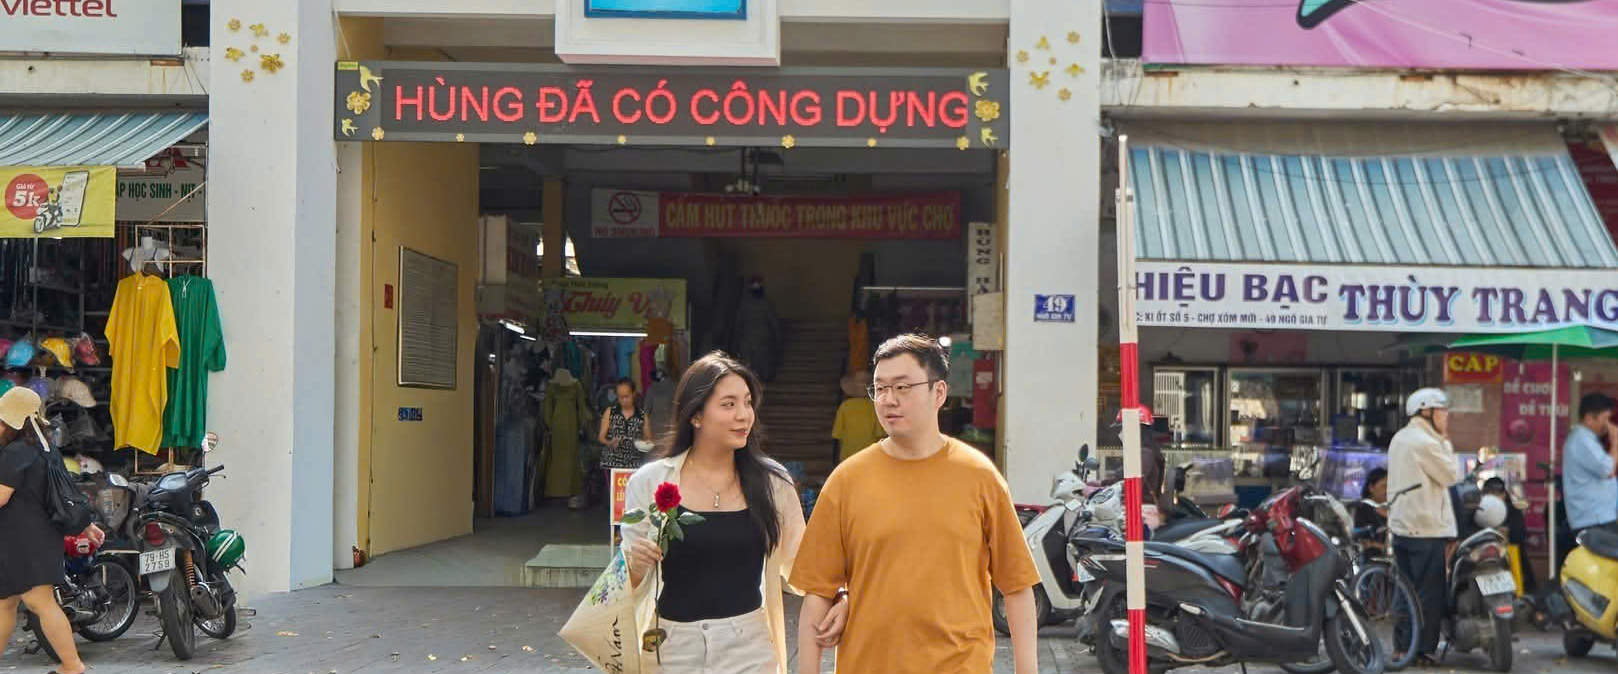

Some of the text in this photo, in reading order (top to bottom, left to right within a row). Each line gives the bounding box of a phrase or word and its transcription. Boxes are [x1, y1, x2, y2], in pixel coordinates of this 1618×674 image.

[394, 76, 969, 133] HÙNG ĐÃ CÓ CÔNG DỰNG
[128, 183, 147, 201] HỌC
[149, 183, 172, 199] SINH
[1136, 266, 1329, 309] HIỆU BẠC
[1339, 274, 1618, 325] THÙY TRANG
[1043, 296, 1066, 313] 49
[1184, 313, 1190, 323] 5
[1198, 312, 1215, 324] CHỢ
[1216, 312, 1238, 324] XÓM
